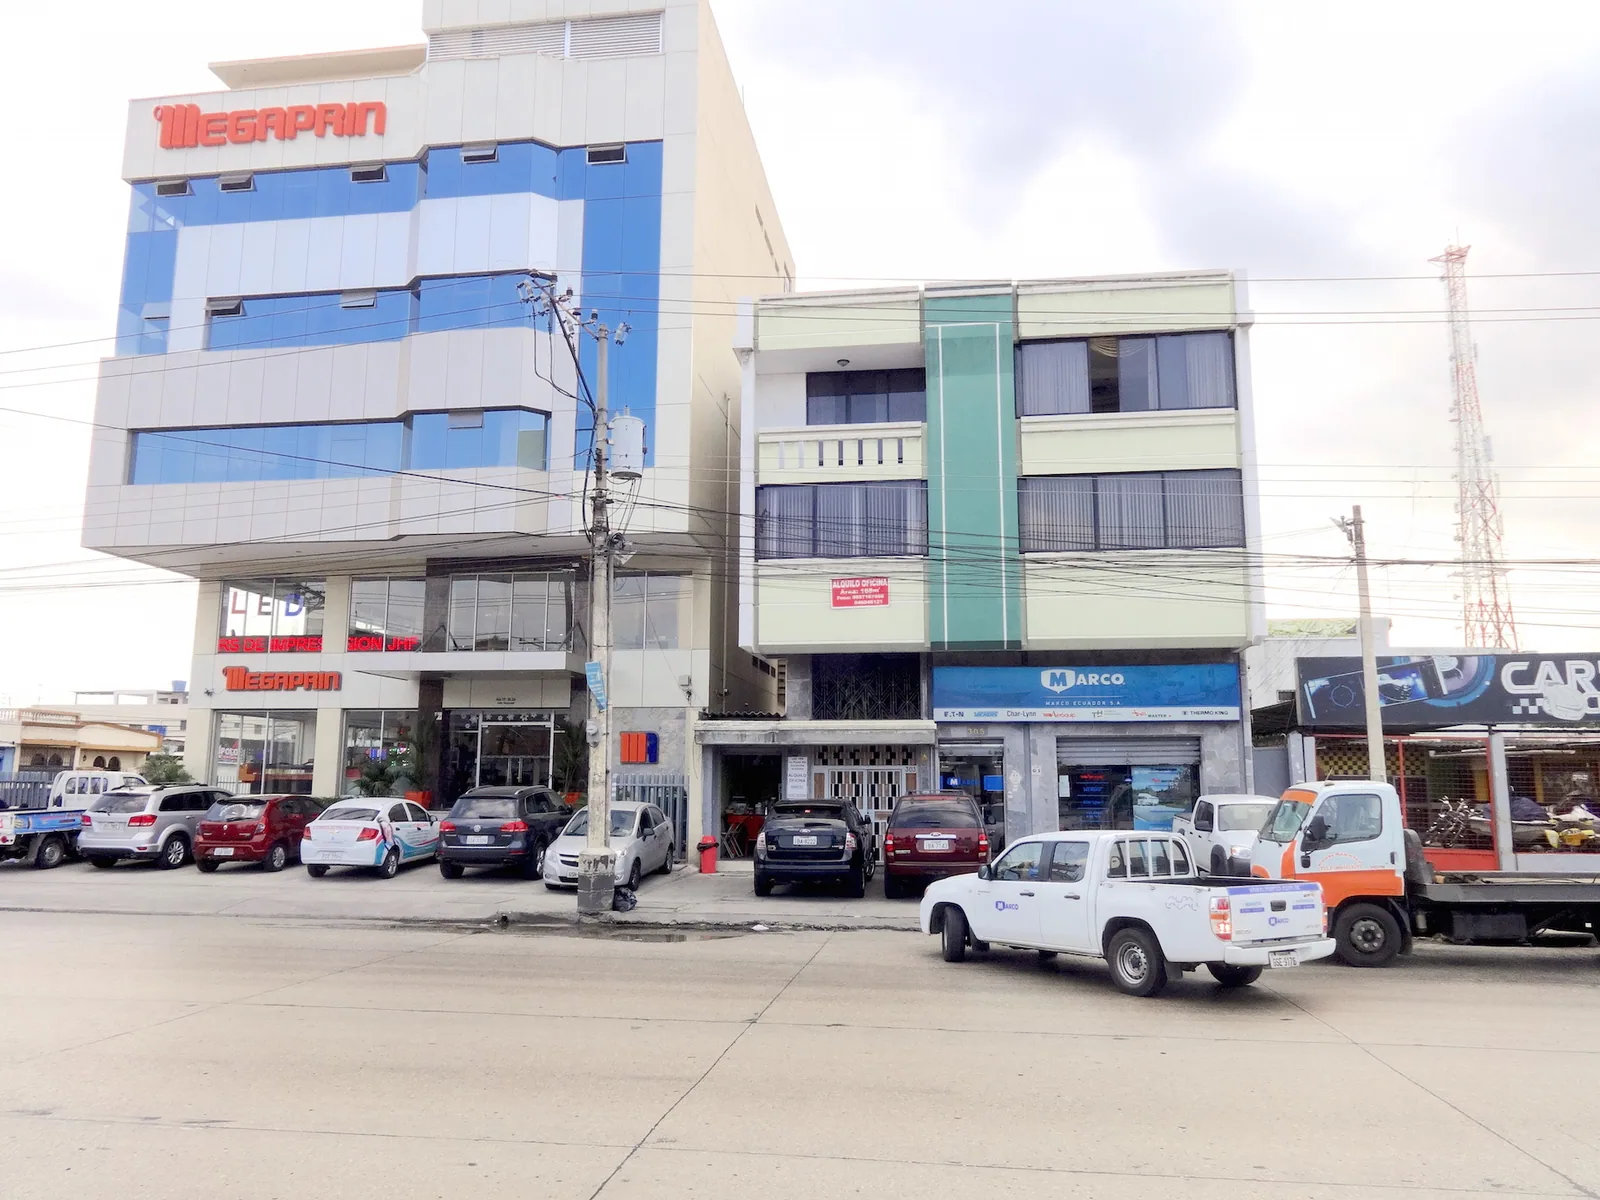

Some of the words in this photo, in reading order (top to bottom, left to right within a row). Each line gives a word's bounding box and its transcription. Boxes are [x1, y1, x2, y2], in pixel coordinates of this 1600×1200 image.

[153, 102, 387, 149] MEGAPRIN
[243, 637, 265, 652] DE
[222, 666, 342, 691] MEGAPRIN
[1047, 671, 1124, 687] MARCO
[1006, 710, 1037, 718] Char-Lynn
